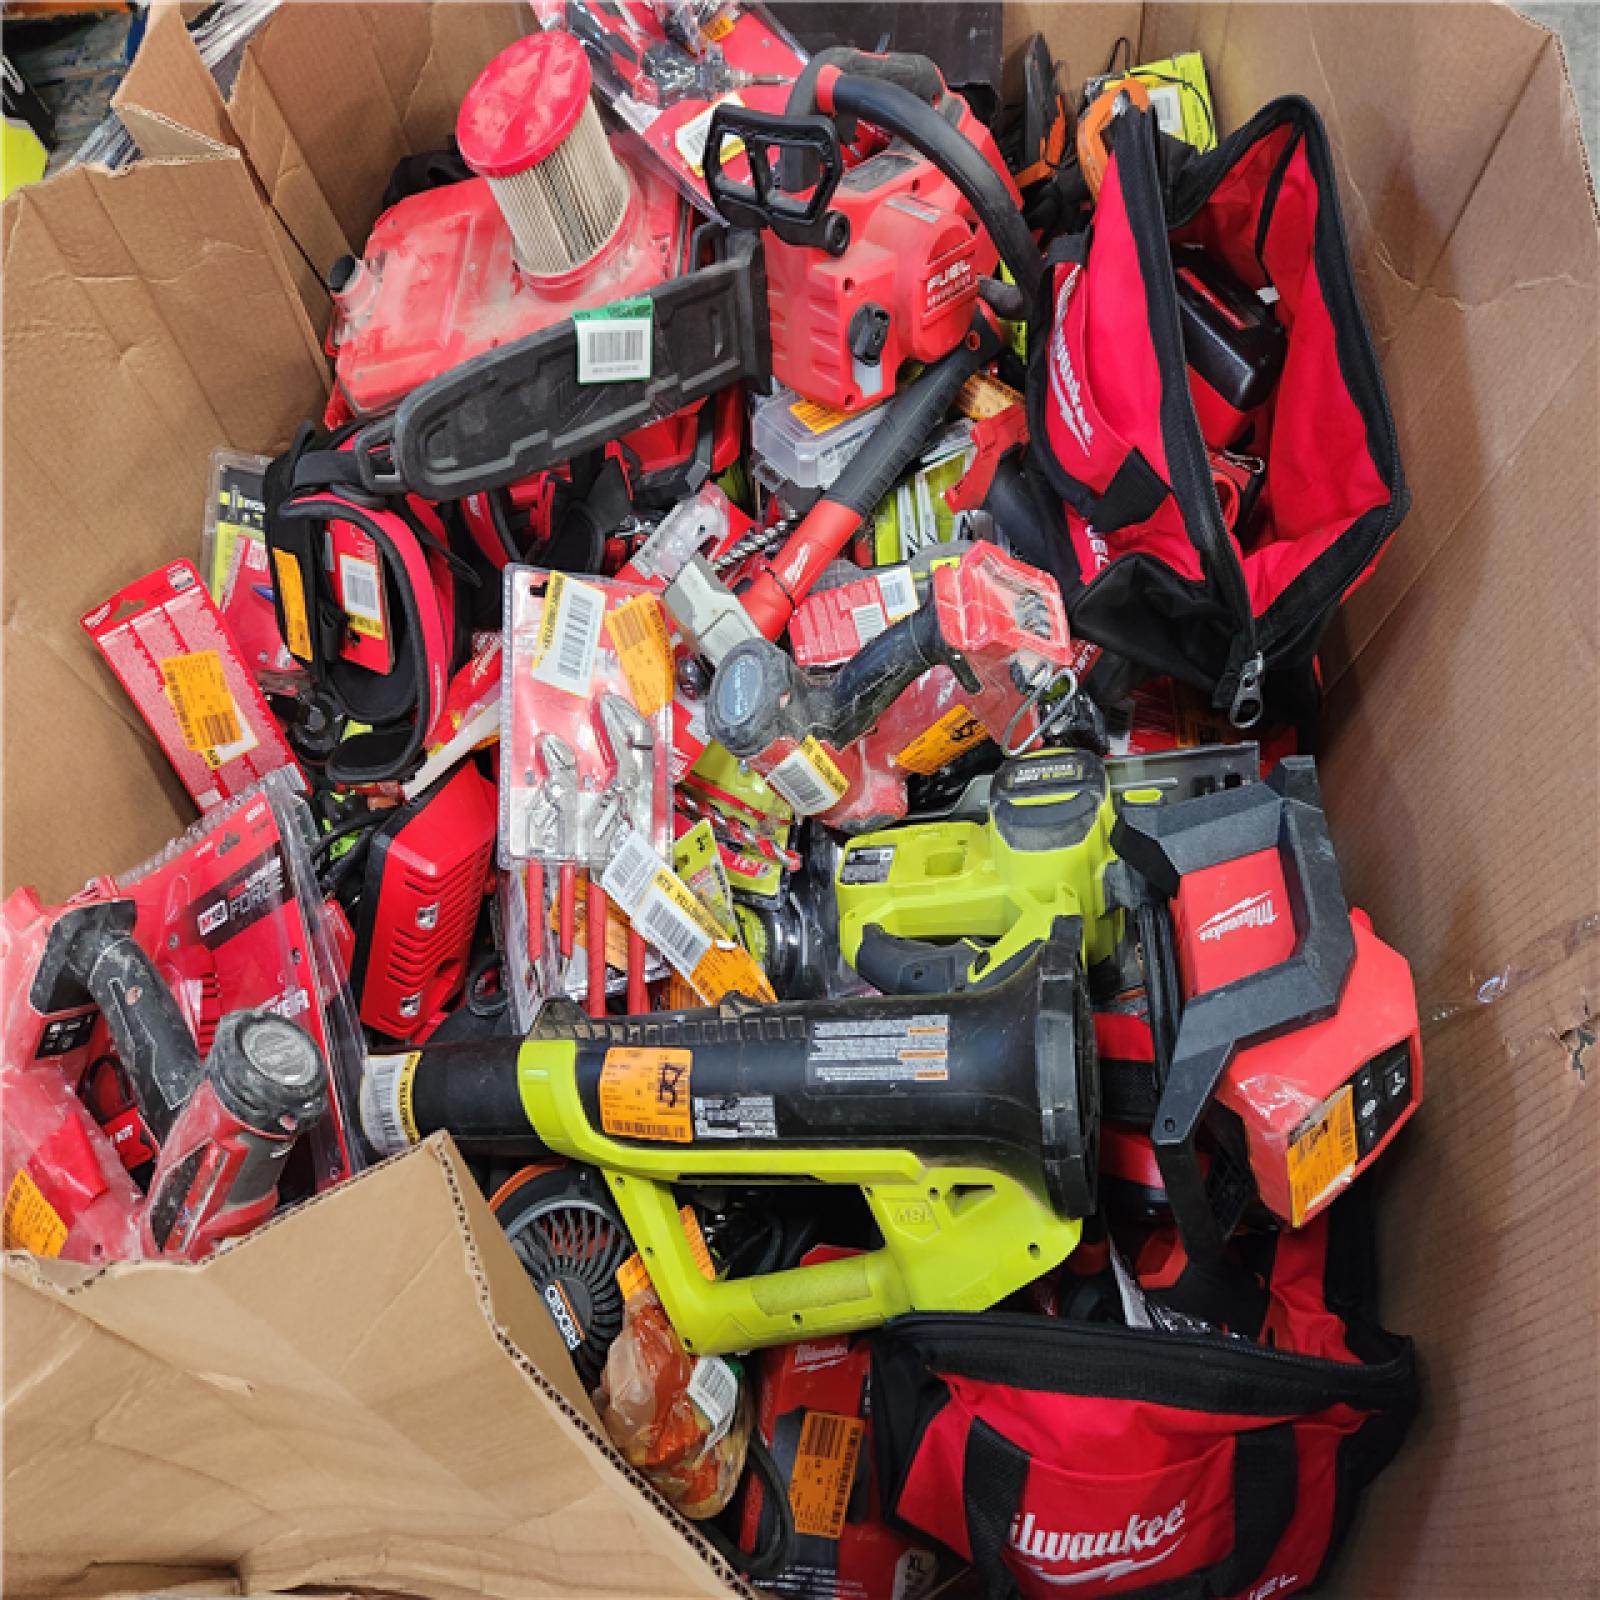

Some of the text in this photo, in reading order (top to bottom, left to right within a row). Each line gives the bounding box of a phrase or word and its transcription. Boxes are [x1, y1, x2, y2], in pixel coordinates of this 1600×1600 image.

[927, 259, 971, 293] FUEL
[229, 870, 284, 921] FORGE
[1008, 1500, 1187, 1562] ilwaukee
